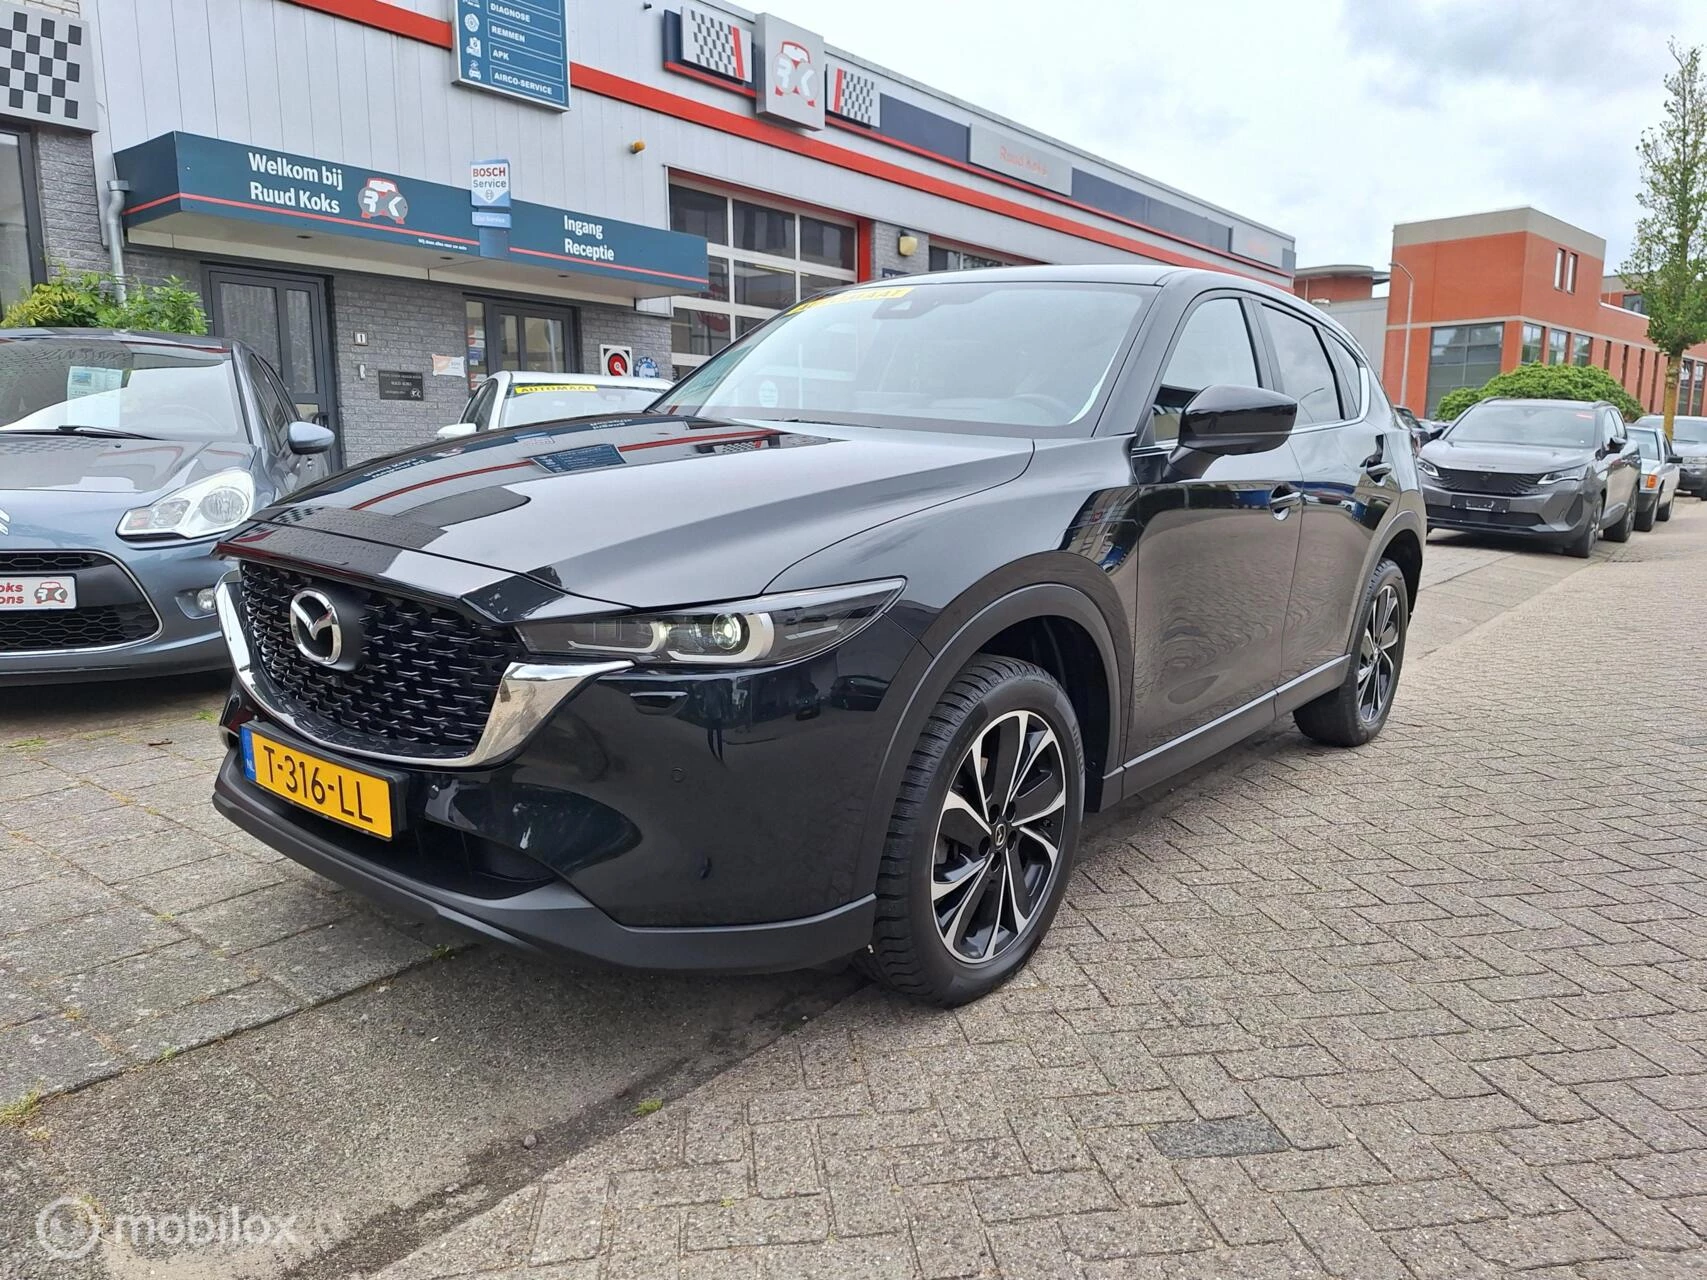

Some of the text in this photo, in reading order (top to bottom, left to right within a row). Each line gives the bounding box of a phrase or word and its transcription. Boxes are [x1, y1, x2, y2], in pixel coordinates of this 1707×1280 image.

[490, 3, 531, 23] DIAGNOSE
[491, 25, 526, 43] REMMEN
[492, 49, 510, 61] APK
[494, 72, 552, 94] AIRCO-SERVICE
[248, 151, 343, 192] Welkom bij
[472, 167, 506, 177] BOSCH
[472, 179, 507, 188] Service
[250, 181, 341, 214] Ruud Koks
[564, 214, 603, 240] Ingang
[564, 238, 615, 261] Receptie
[245, 759, 255, 773] NL
[263, 745, 373, 824] T-316-LL
